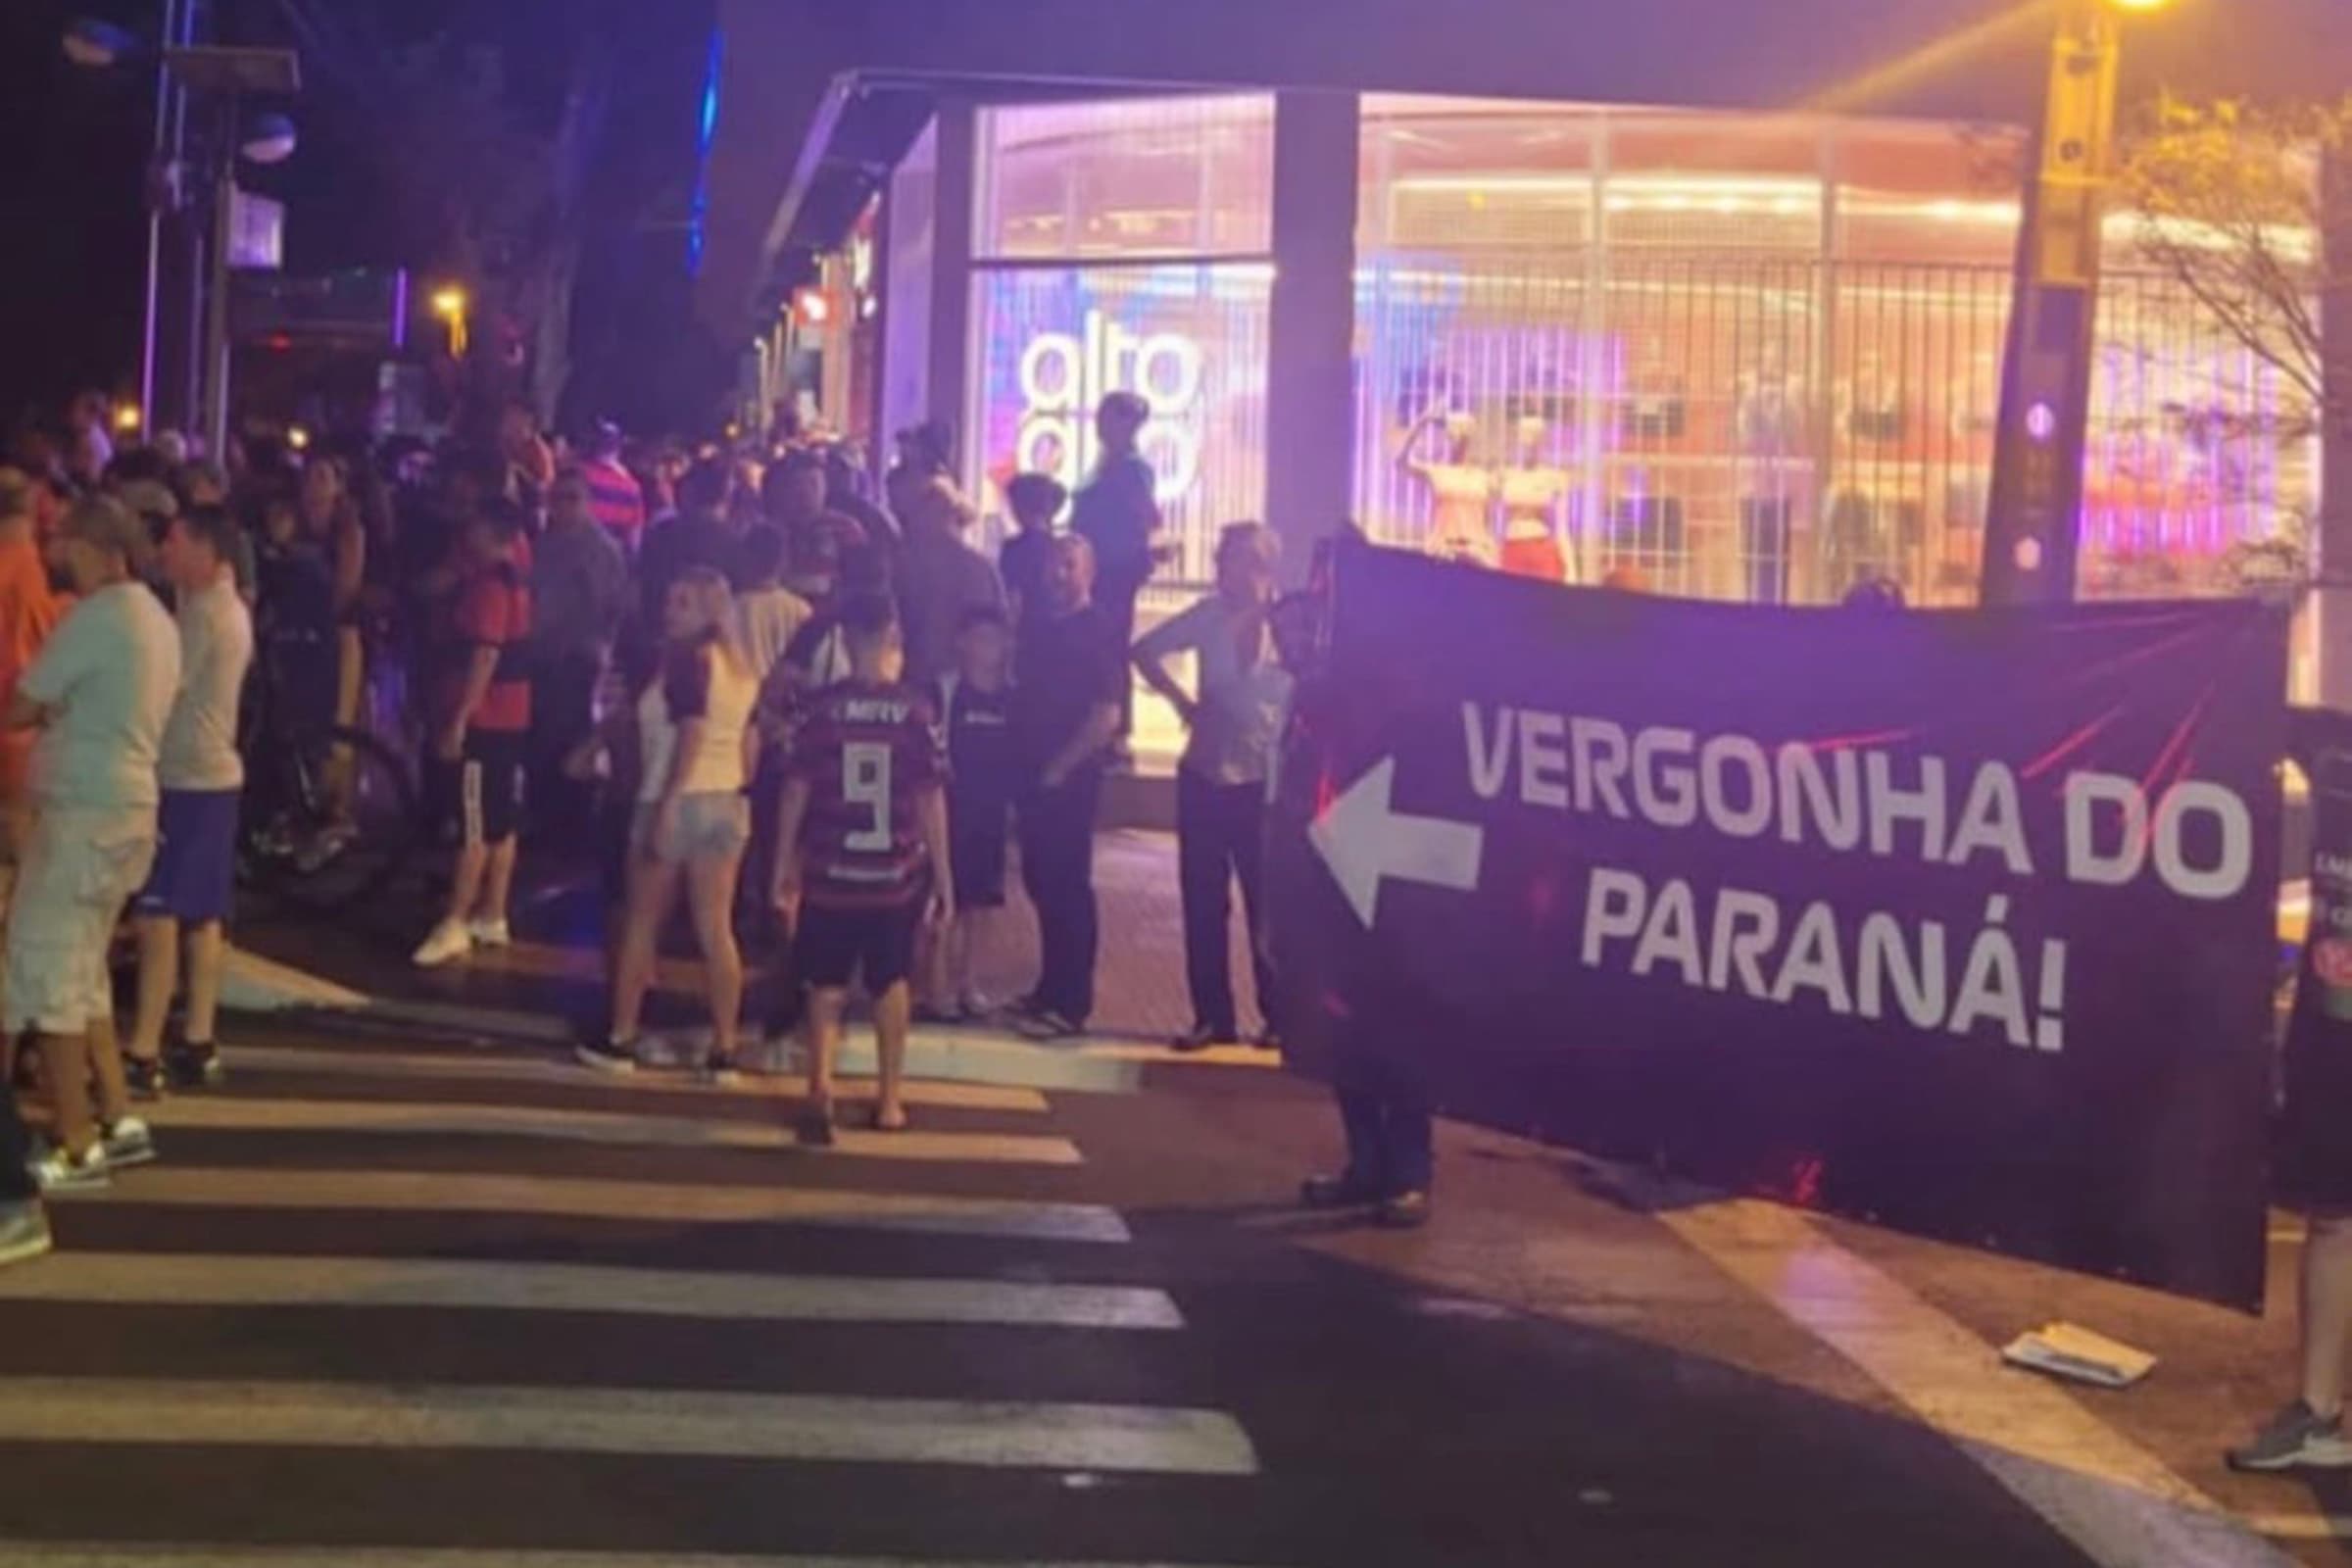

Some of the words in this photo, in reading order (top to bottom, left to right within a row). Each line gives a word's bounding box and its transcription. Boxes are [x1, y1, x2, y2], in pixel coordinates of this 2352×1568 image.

[1020, 309, 1200, 413] alto
[844, 742, 891, 851] 9
[1461, 700, 2034, 875] VERGONHA
[2063, 769, 2252, 899] DO
[1580, 867, 2067, 1052] PARANÁ!
